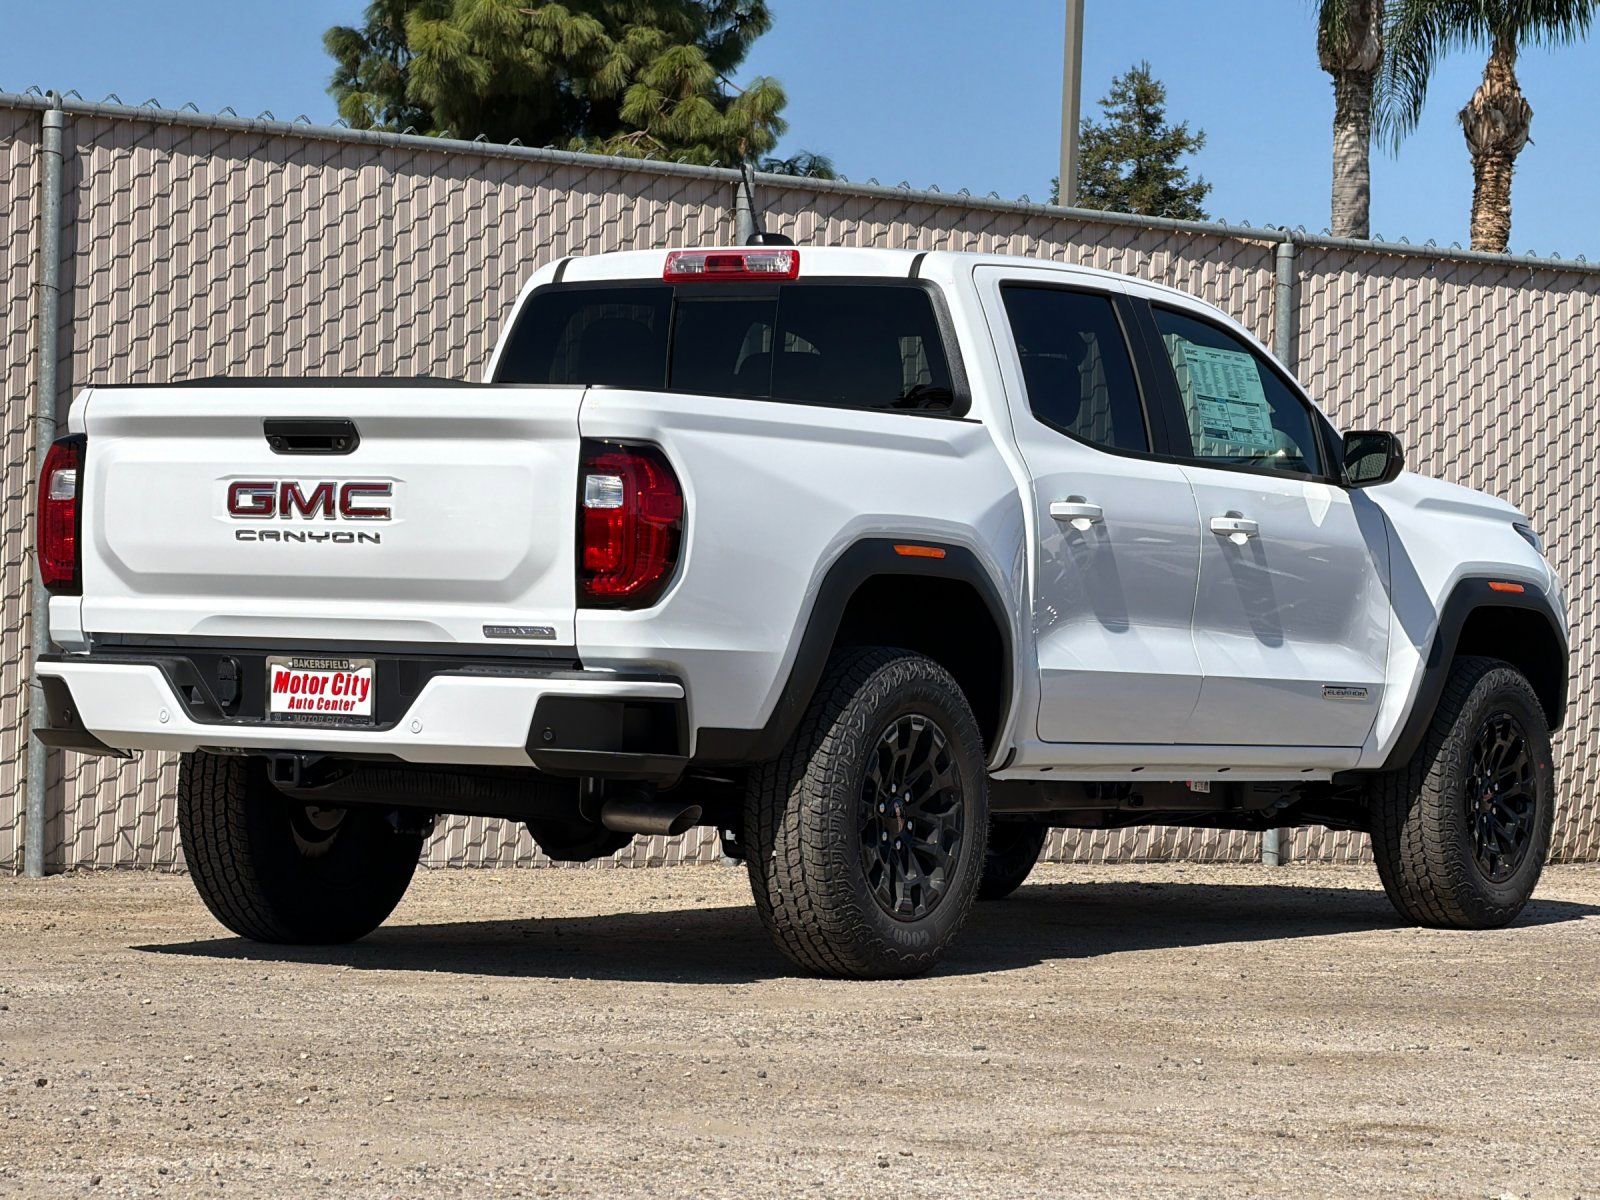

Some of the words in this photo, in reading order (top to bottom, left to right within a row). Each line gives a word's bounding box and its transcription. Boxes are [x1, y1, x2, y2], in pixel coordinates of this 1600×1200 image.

[227, 481, 392, 521] GMC
[235, 529, 381, 544] CANYON
[293, 659, 349, 669] BAKERSFIELD
[273, 671, 329, 695] Motor
[331, 672, 370, 702] City
[288, 696, 314, 709] Auto
[316, 697, 356, 711] Center
